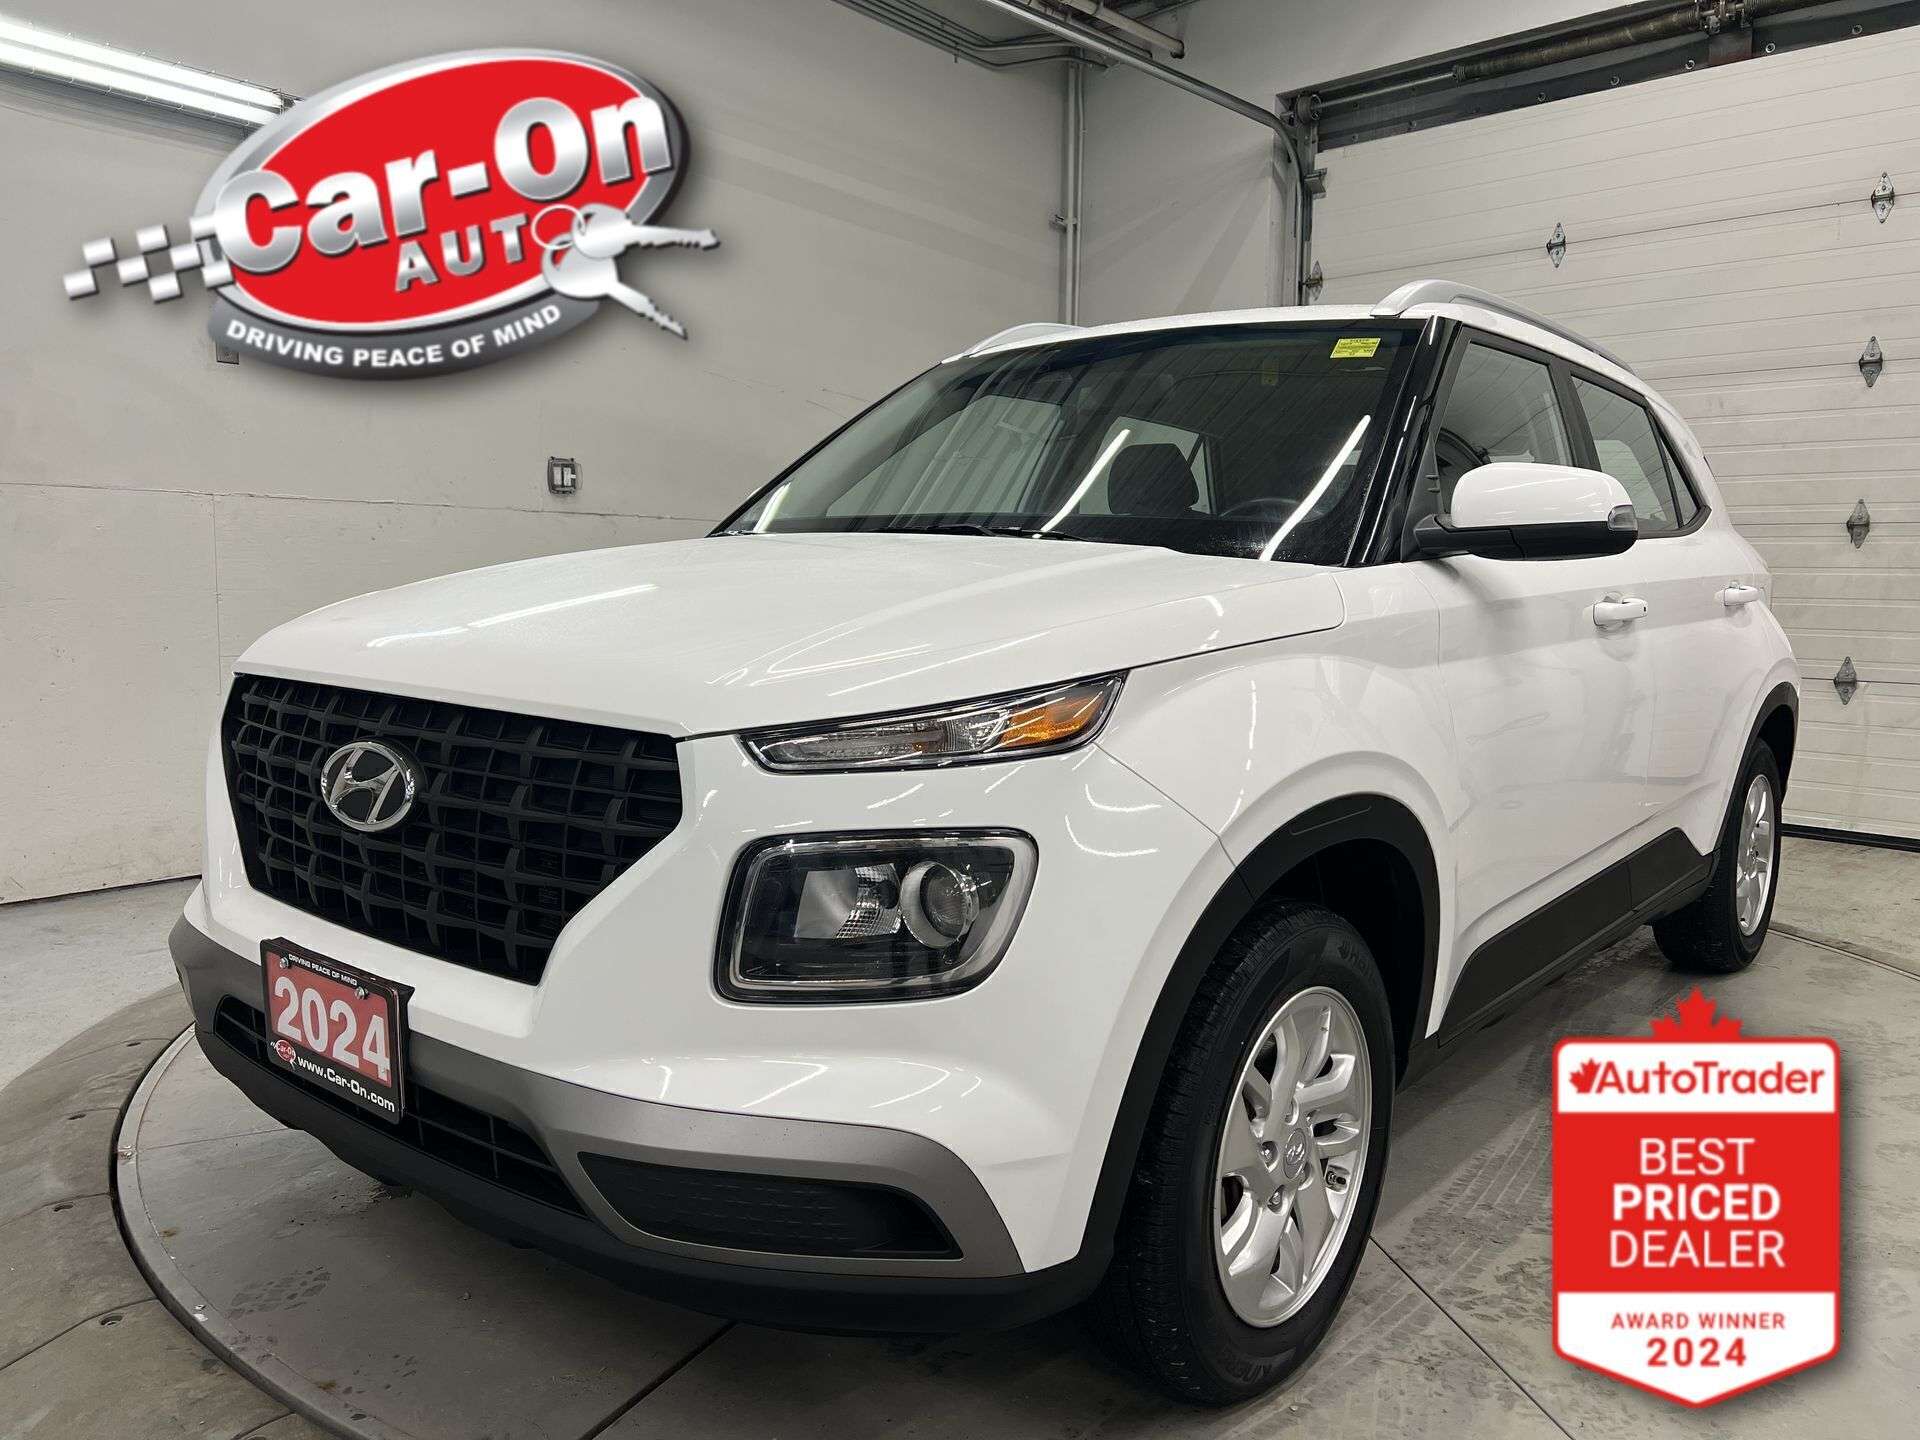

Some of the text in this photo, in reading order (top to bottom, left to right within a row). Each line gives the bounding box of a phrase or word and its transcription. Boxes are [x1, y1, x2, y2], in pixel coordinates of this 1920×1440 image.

[311, 962, 331, 976] PEACE
[331, 970, 340, 979] OF
[274, 976, 391, 1082] 2024
[297, 1055, 396, 1113] www.Car-On.com
